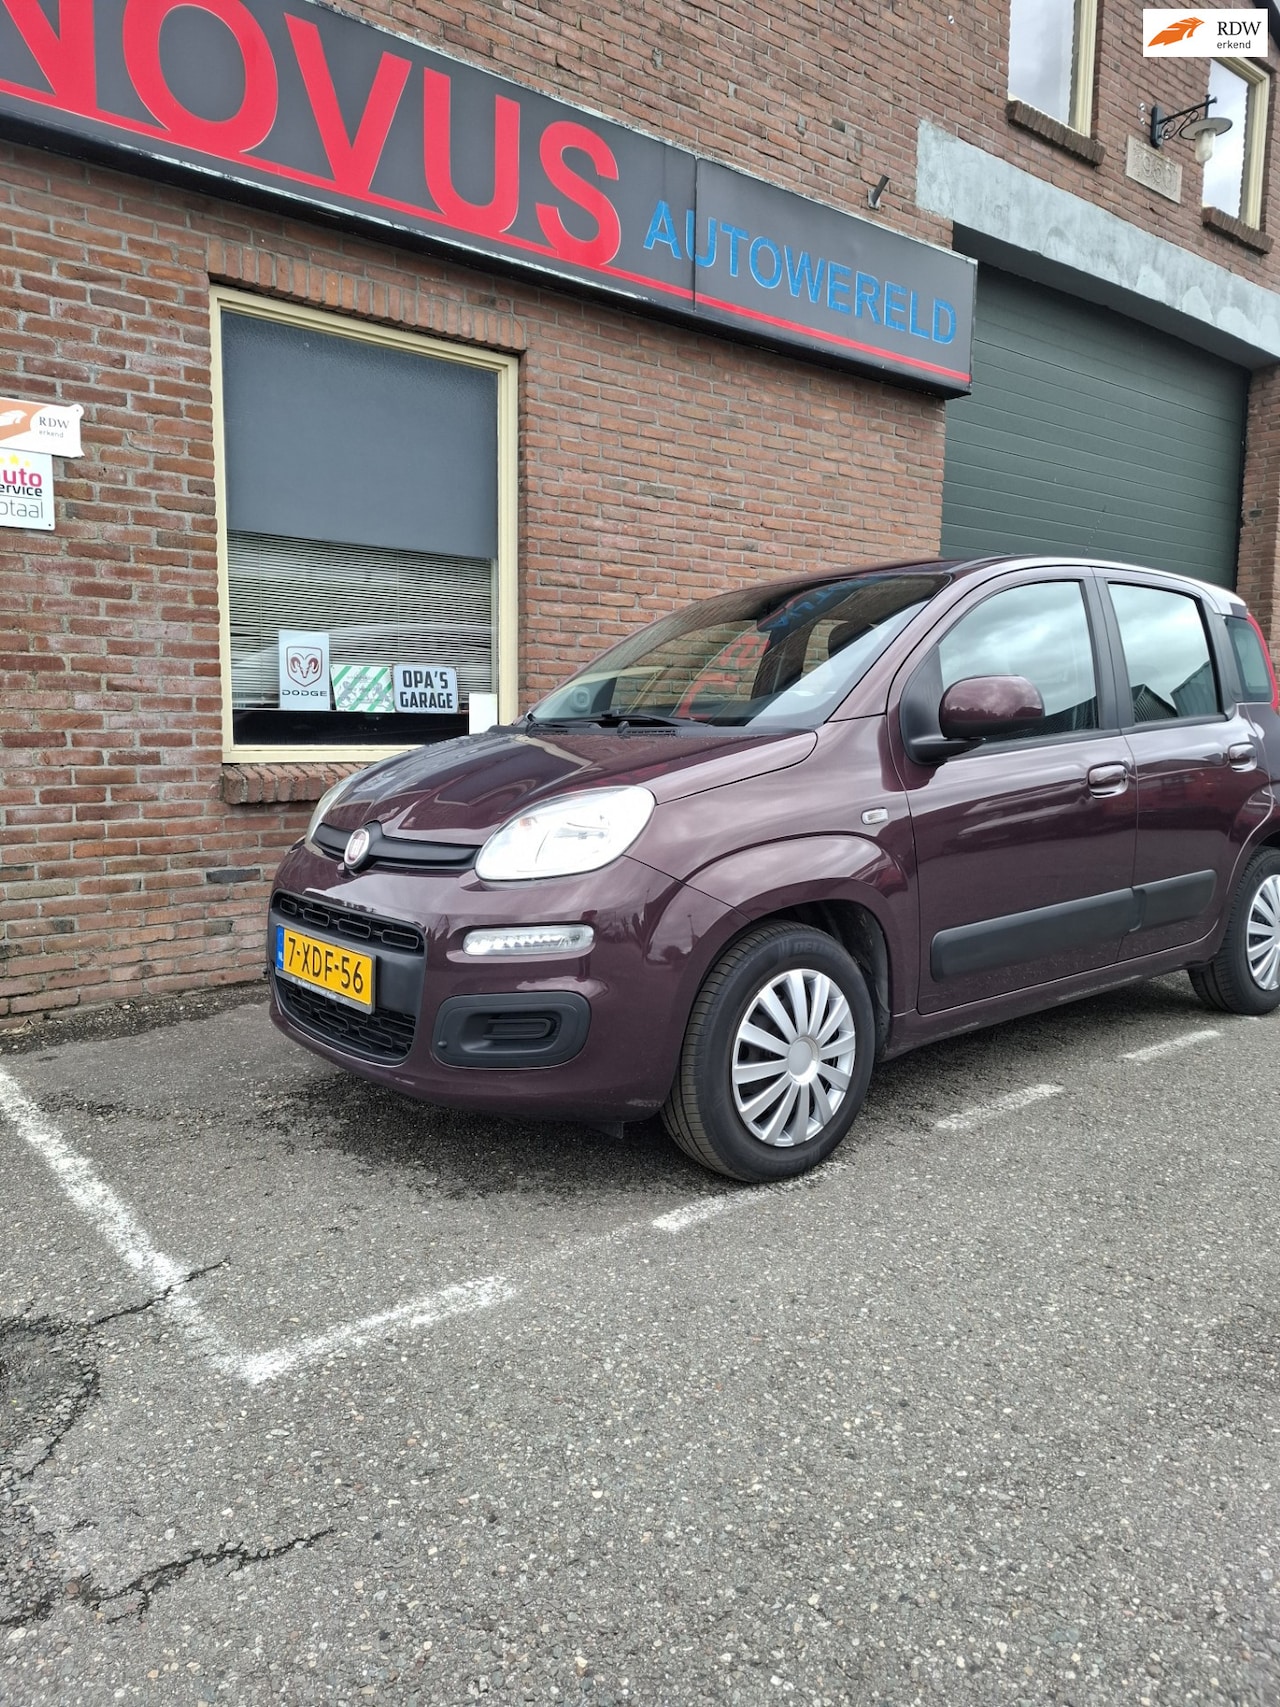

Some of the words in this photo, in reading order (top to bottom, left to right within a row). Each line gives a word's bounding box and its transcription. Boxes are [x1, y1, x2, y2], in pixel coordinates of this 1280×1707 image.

[643, 200, 957, 345] AUTOWERELD
[39, 416, 70, 429] RDW
[39, 429, 64, 438] erkend
[1, 468, 42, 487] uto
[0, 483, 43, 497] ervice
[0, 499, 43, 519] otaal
[402, 670, 449, 689] OPA'S
[400, 691, 453, 709] GARAGE
[288, 937, 364, 994] 7-XDF-56
